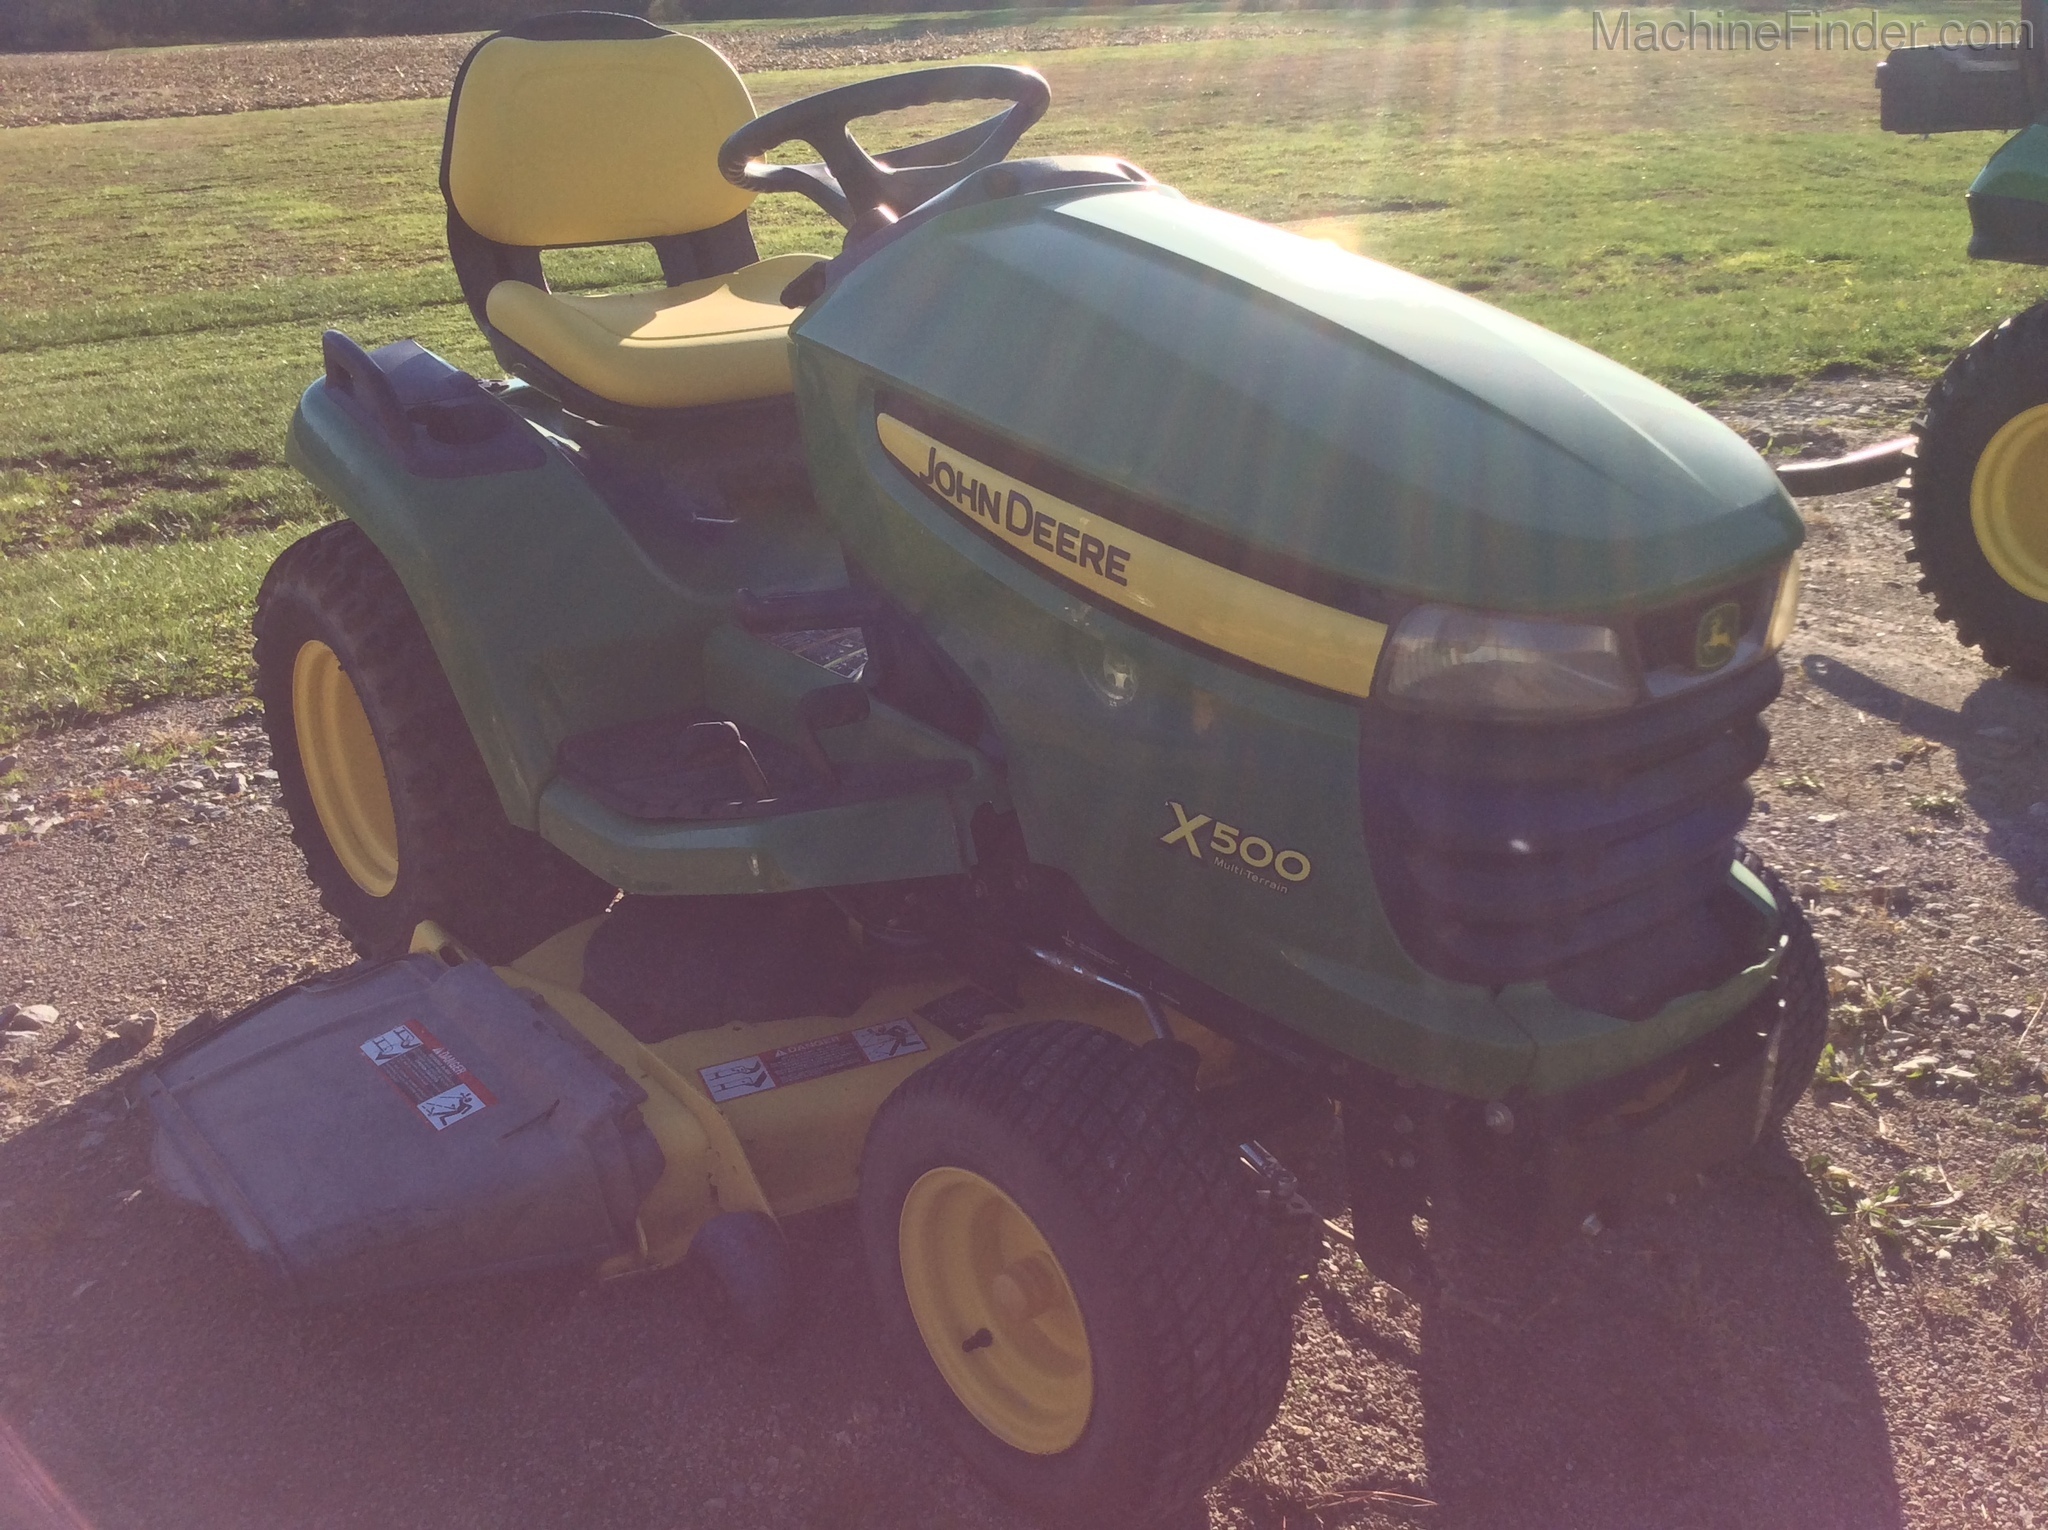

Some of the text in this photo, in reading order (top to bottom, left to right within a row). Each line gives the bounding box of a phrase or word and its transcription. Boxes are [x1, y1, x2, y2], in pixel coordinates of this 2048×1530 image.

[919, 447, 1131, 586] JOHN DEERE
[1160, 801, 1311, 882] X500
[1213, 856, 1289, 894] Multi-Terrain
[440, 1051, 467, 1075] DANGER
[787, 1036, 840, 1053] DANGER
